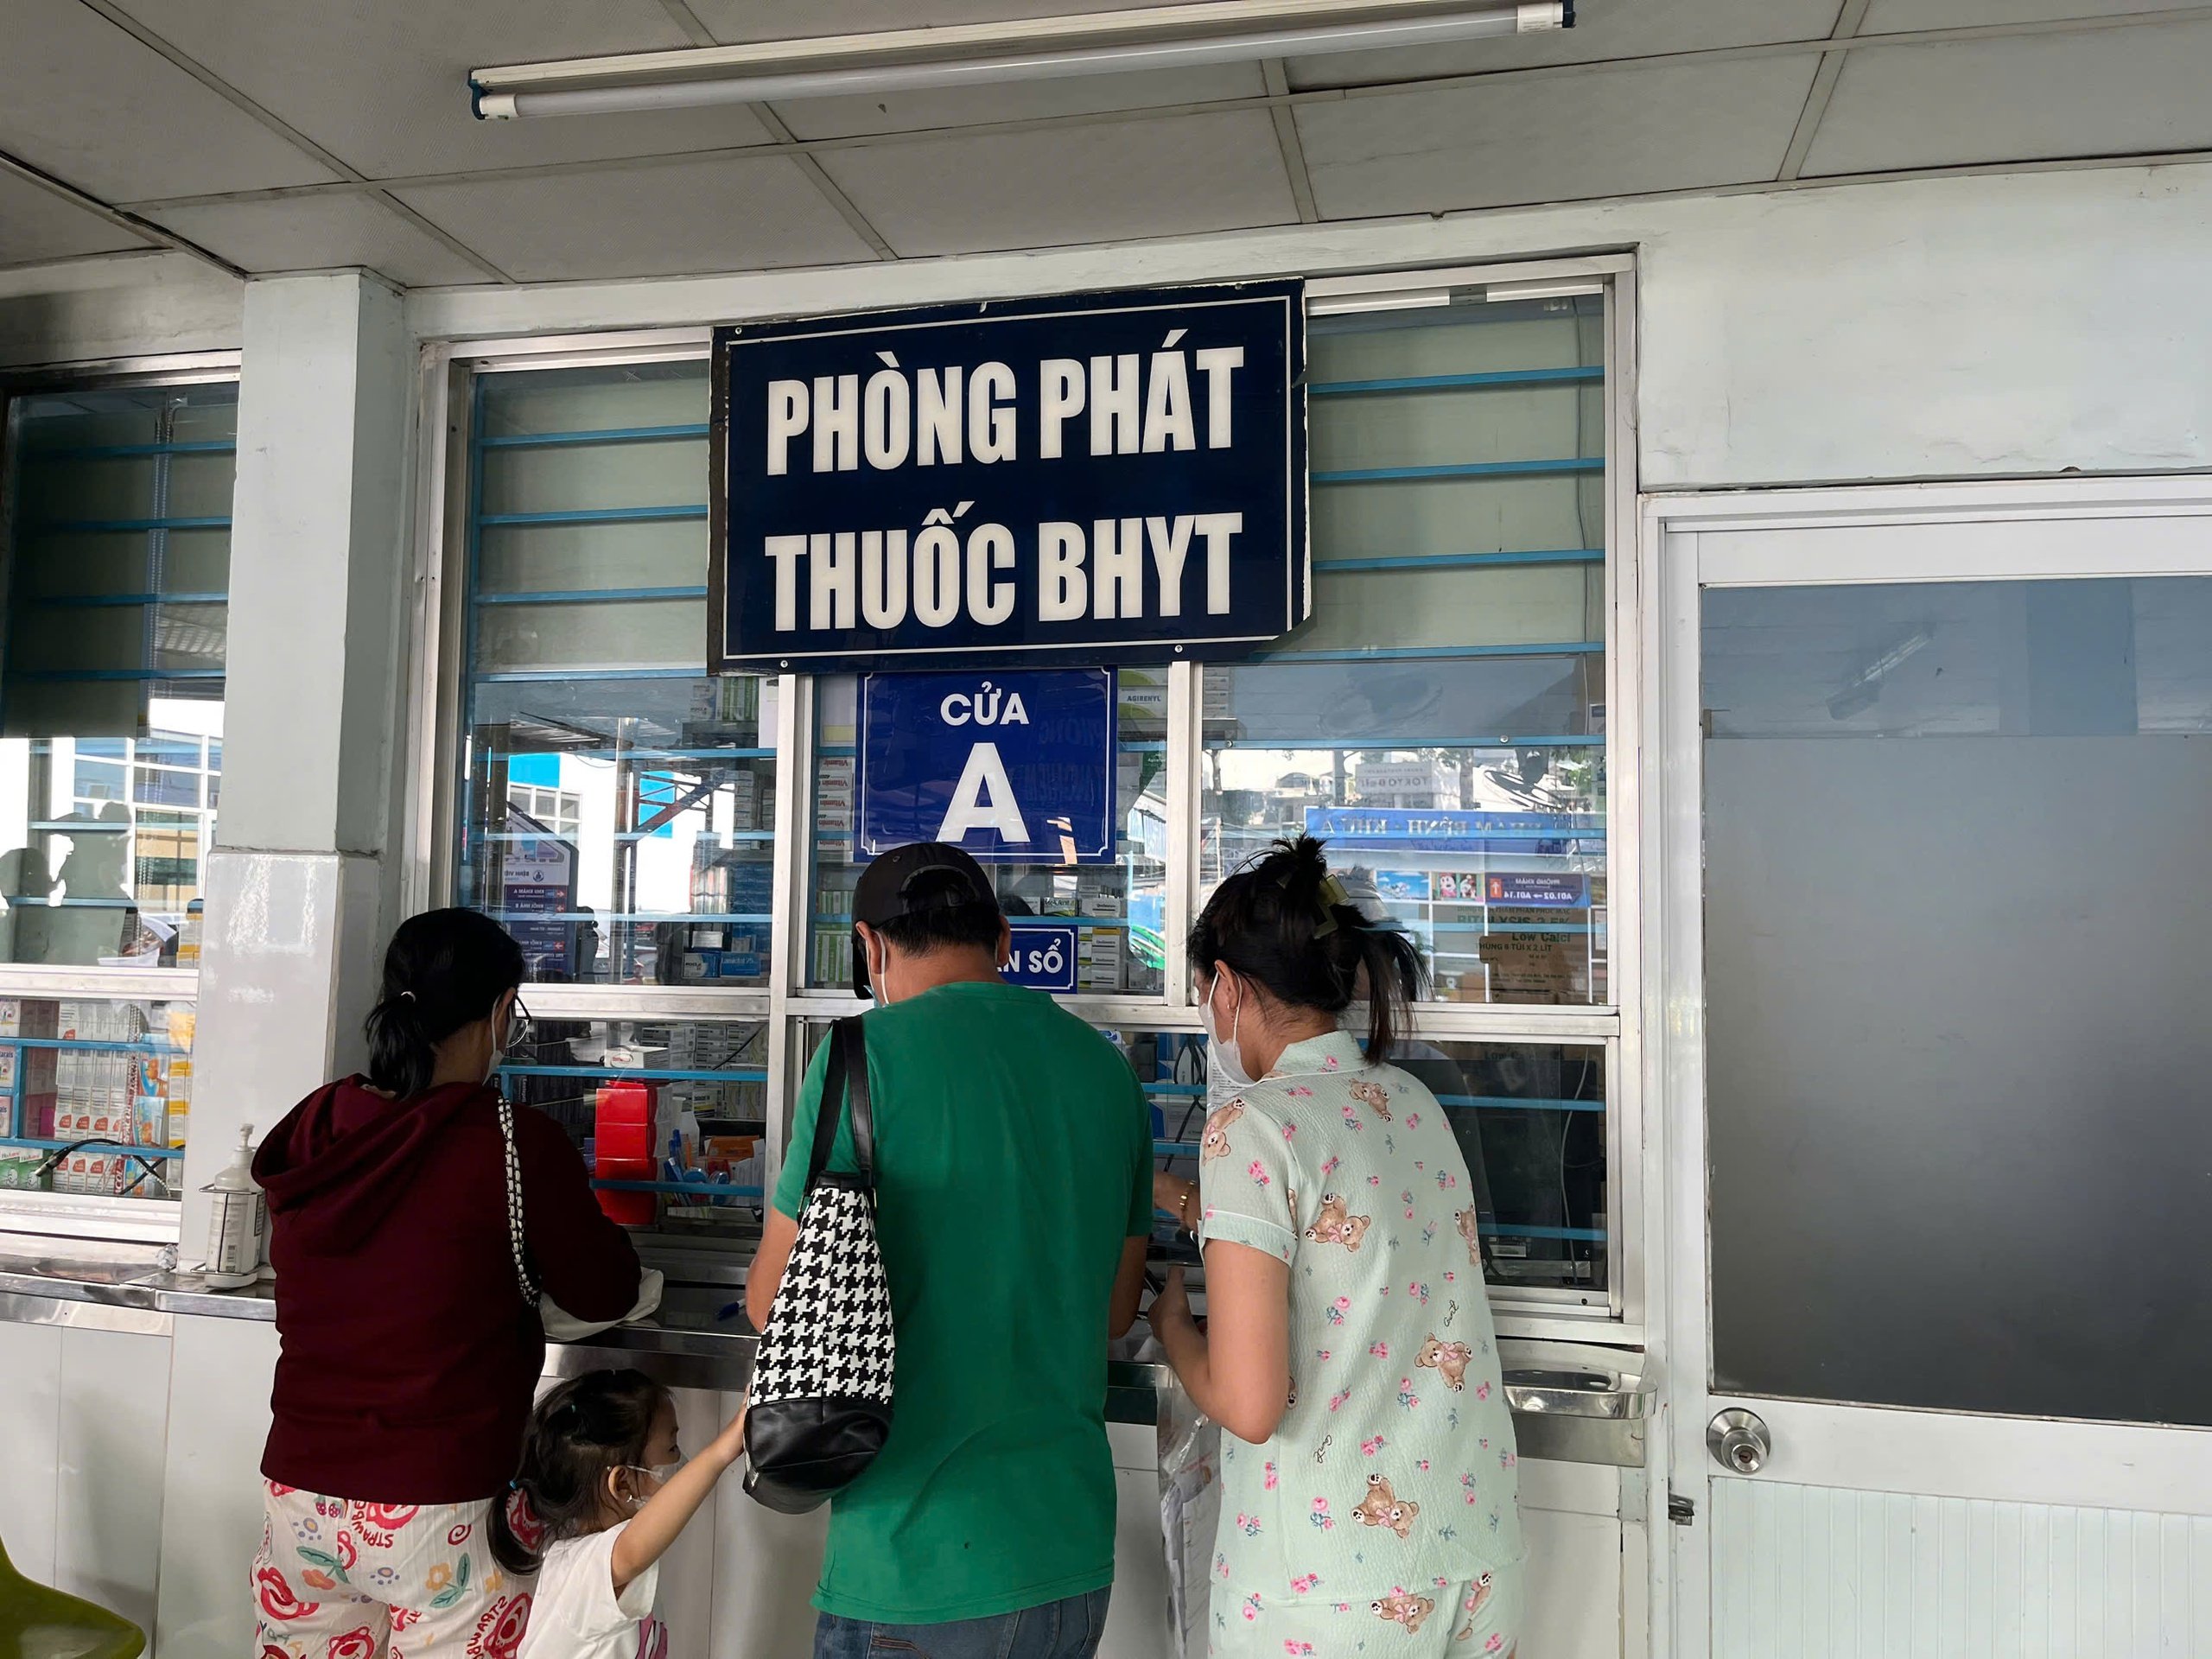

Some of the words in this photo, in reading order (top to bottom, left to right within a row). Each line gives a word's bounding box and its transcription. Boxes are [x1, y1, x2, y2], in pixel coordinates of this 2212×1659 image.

[766, 351, 1017, 476] PHÒNG
[1039, 328, 1244, 460] PHÁT
[765, 500, 1016, 632] THUỐC
[1038, 512, 1243, 622] BHYT
[940, 681, 1030, 726] CỬA
[935, 742, 1031, 842] A
[1028, 938, 1064, 974] SỔ
